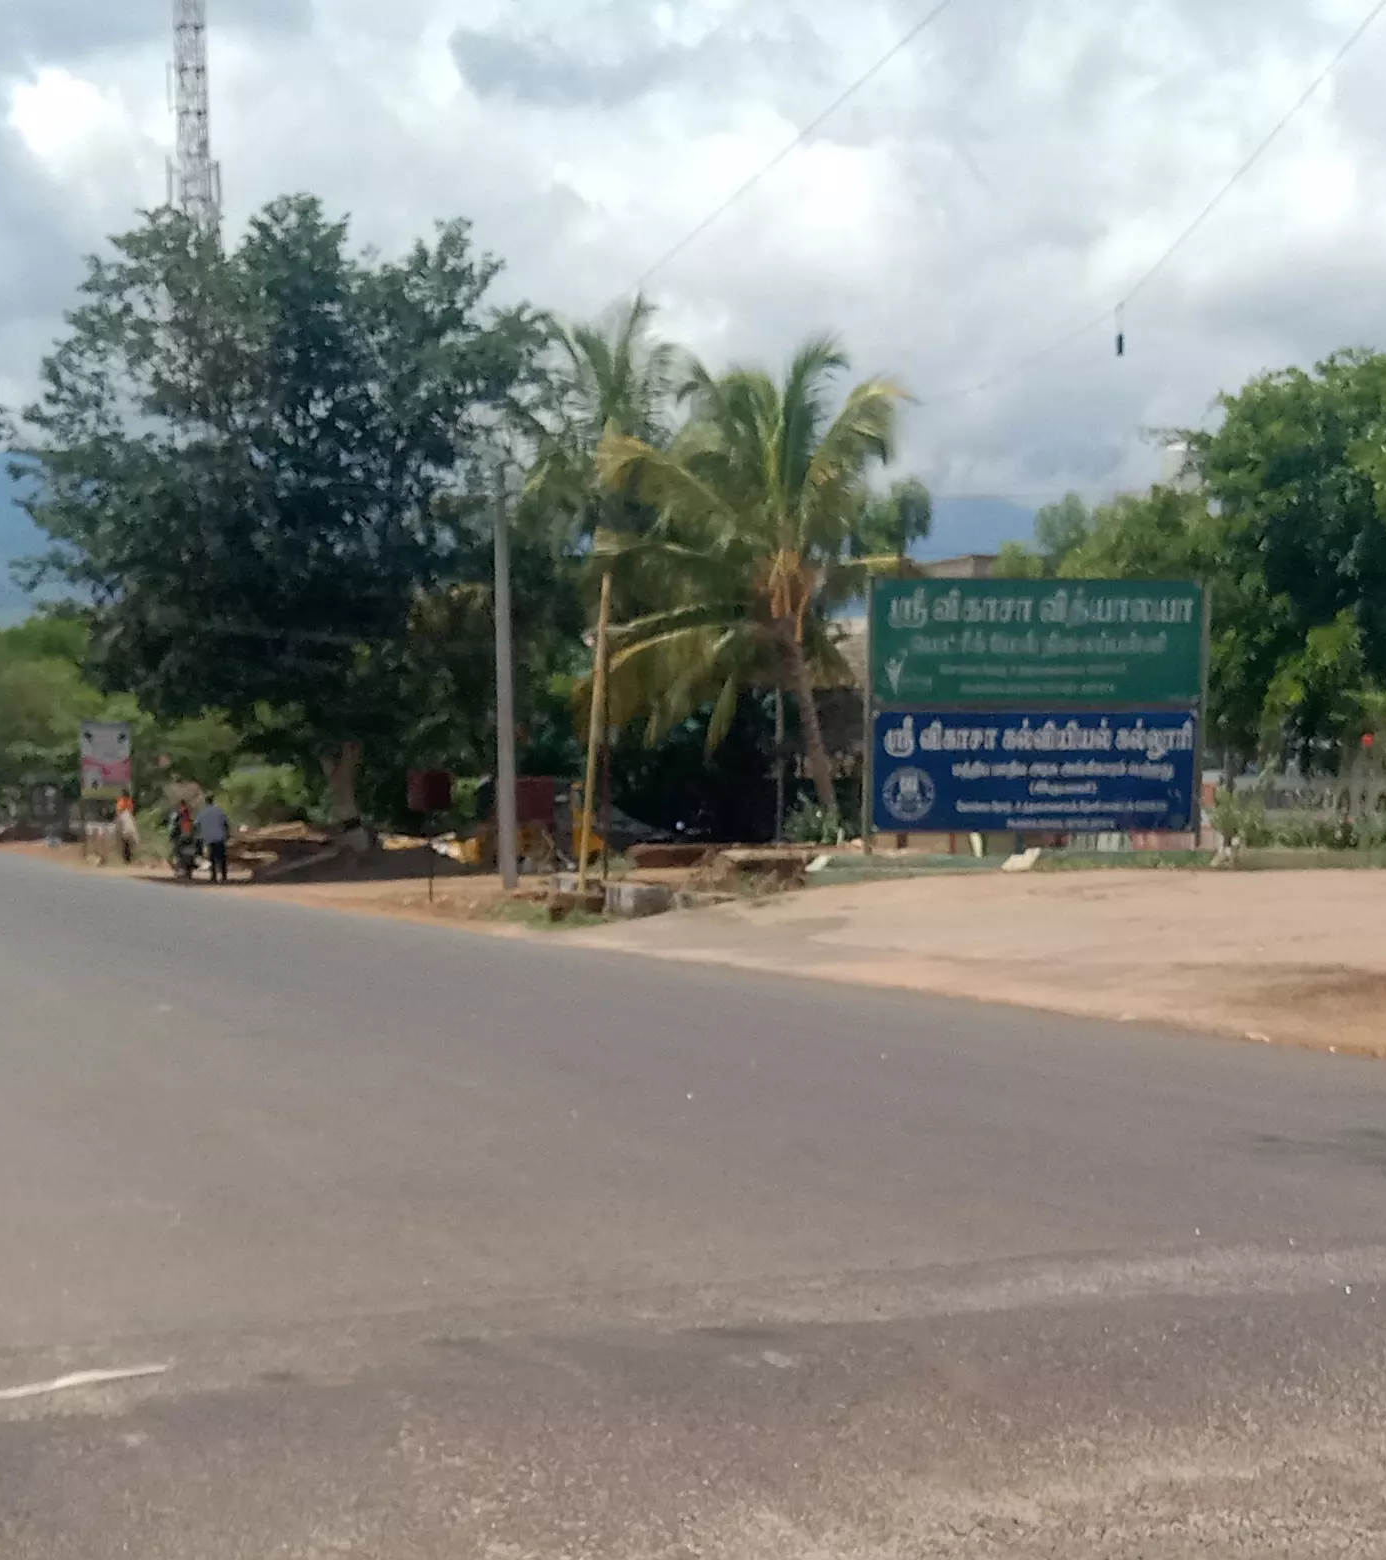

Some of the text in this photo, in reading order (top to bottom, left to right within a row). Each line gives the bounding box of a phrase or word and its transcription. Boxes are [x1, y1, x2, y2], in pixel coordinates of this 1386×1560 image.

[888, 587, 1194, 628] ஸ்ரீ விகாசா வித்யாலயா
[884, 715, 1194, 760] ஸ்ரீ விகாசா கல்வியியல் கல்லூரி
